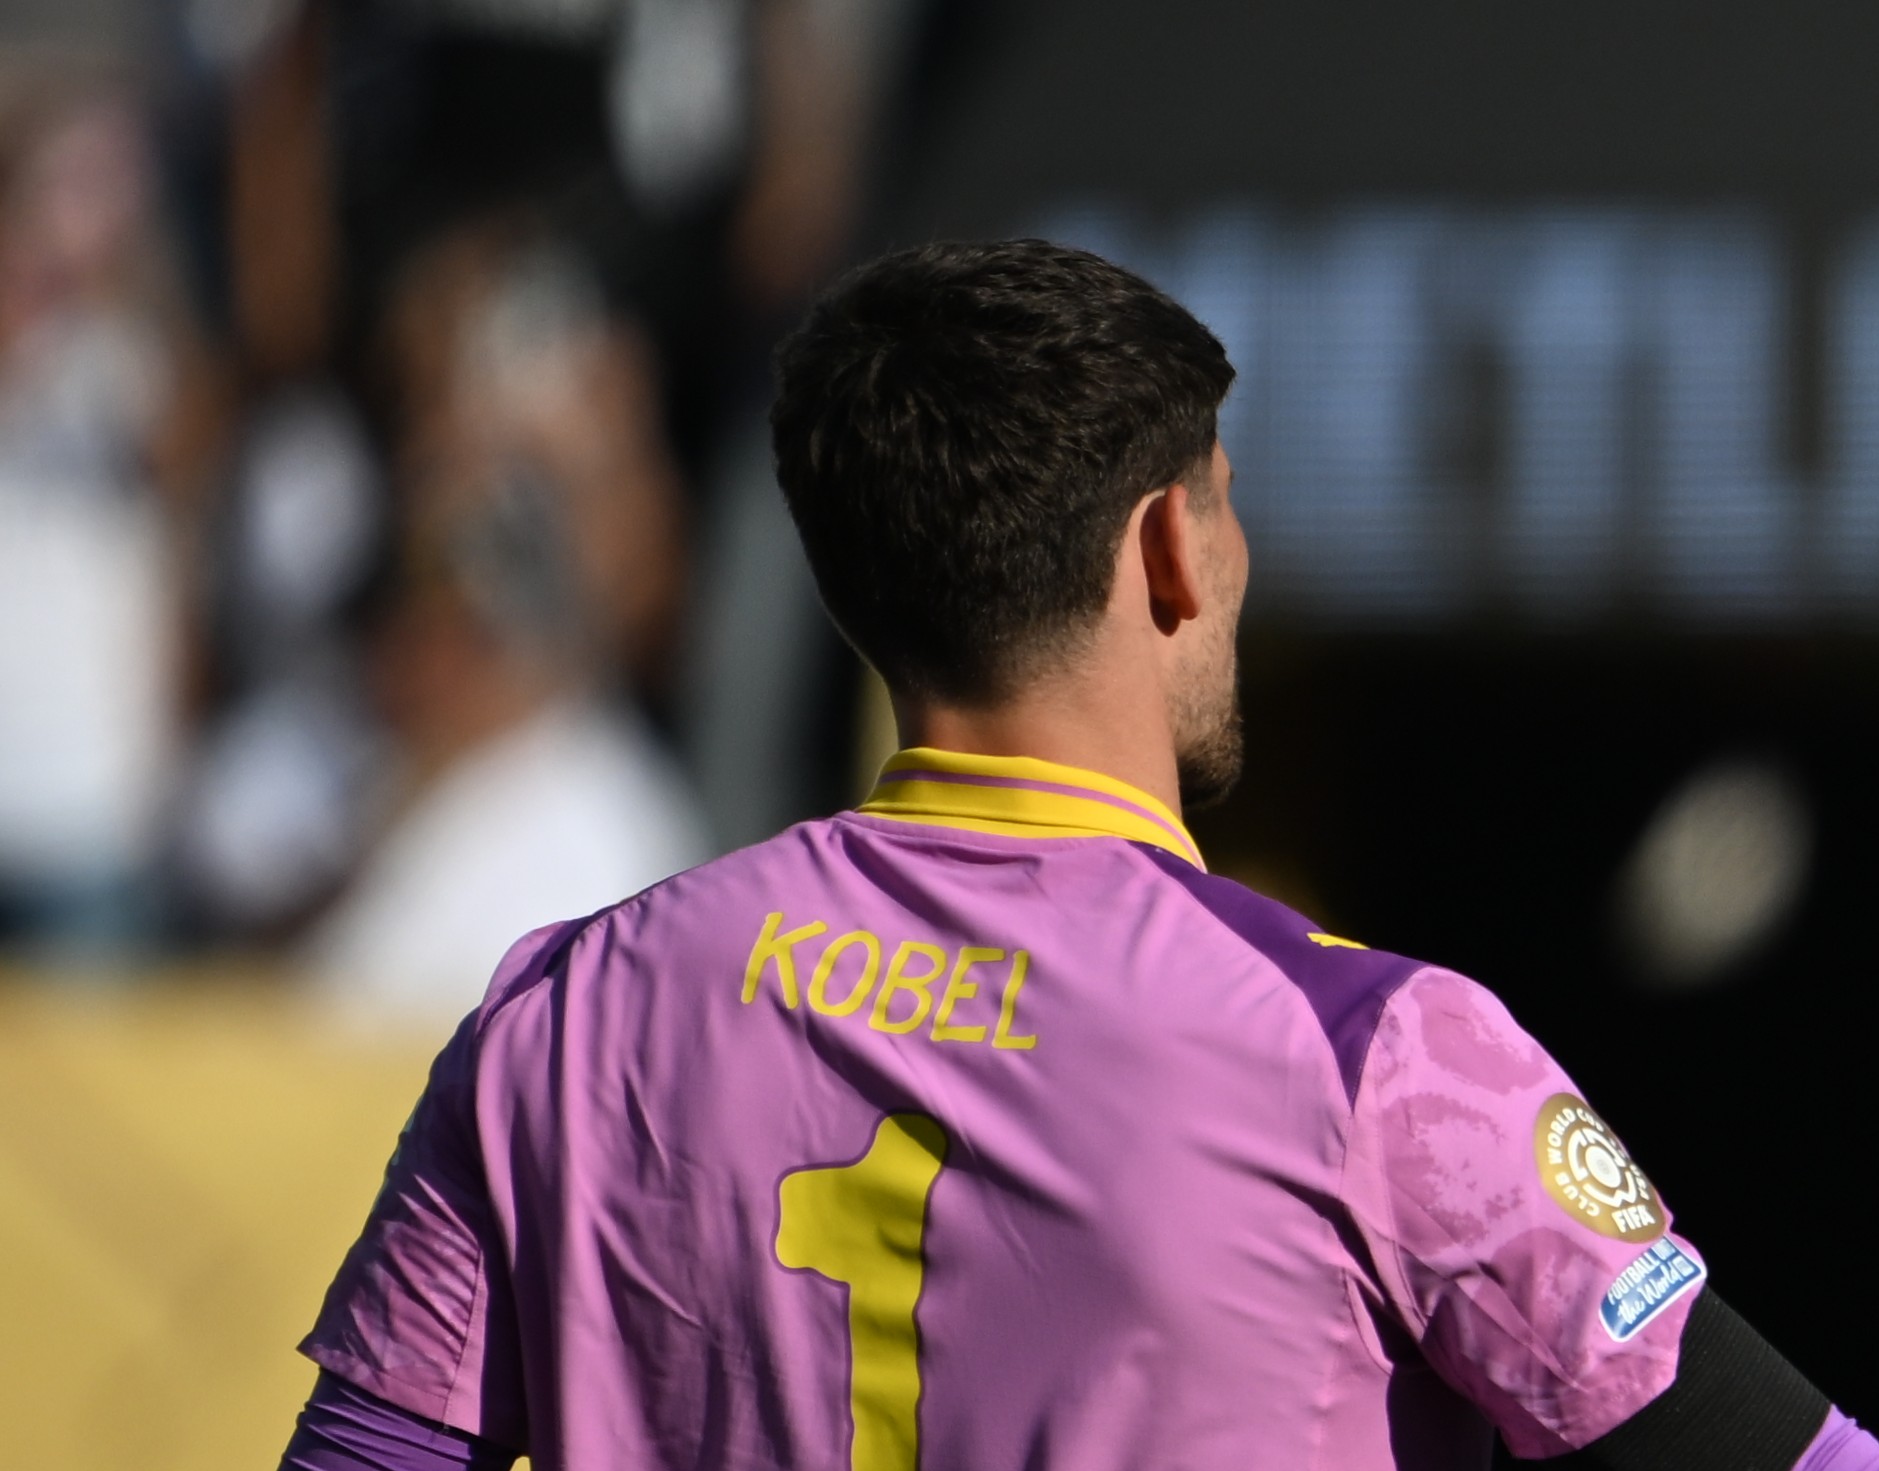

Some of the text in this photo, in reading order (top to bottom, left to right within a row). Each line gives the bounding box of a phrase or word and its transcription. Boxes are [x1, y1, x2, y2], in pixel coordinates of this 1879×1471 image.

[741, 912, 1036, 1050] KOBEL
[1547, 1108, 1576, 1165] WORLD
[1555, 1172, 1600, 1217] CLUB
[1611, 1204, 1655, 1233] FIFA
